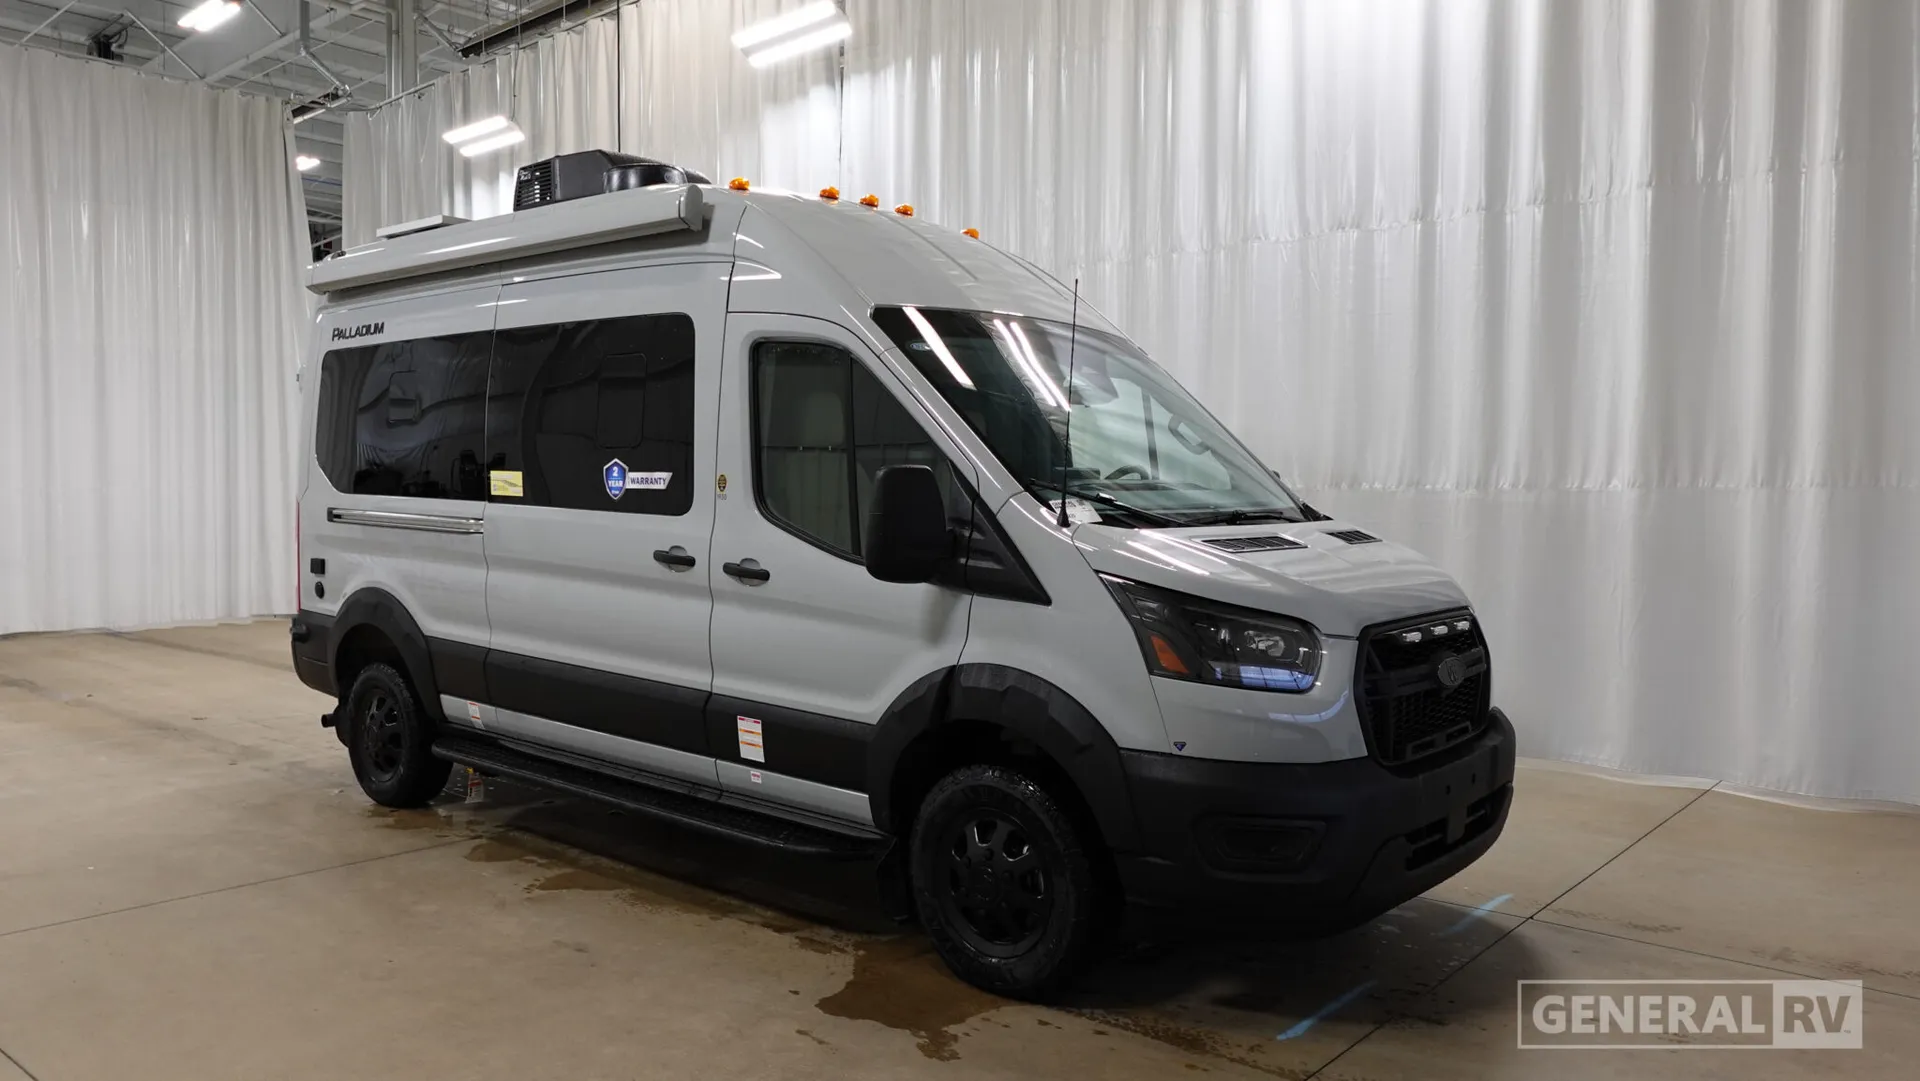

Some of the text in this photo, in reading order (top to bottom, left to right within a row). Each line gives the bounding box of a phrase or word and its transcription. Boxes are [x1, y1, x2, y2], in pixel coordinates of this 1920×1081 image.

[332, 322, 385, 341] PALLADIUM
[612, 466, 619, 477] 2
[630, 477, 667, 485] WARRANTY
